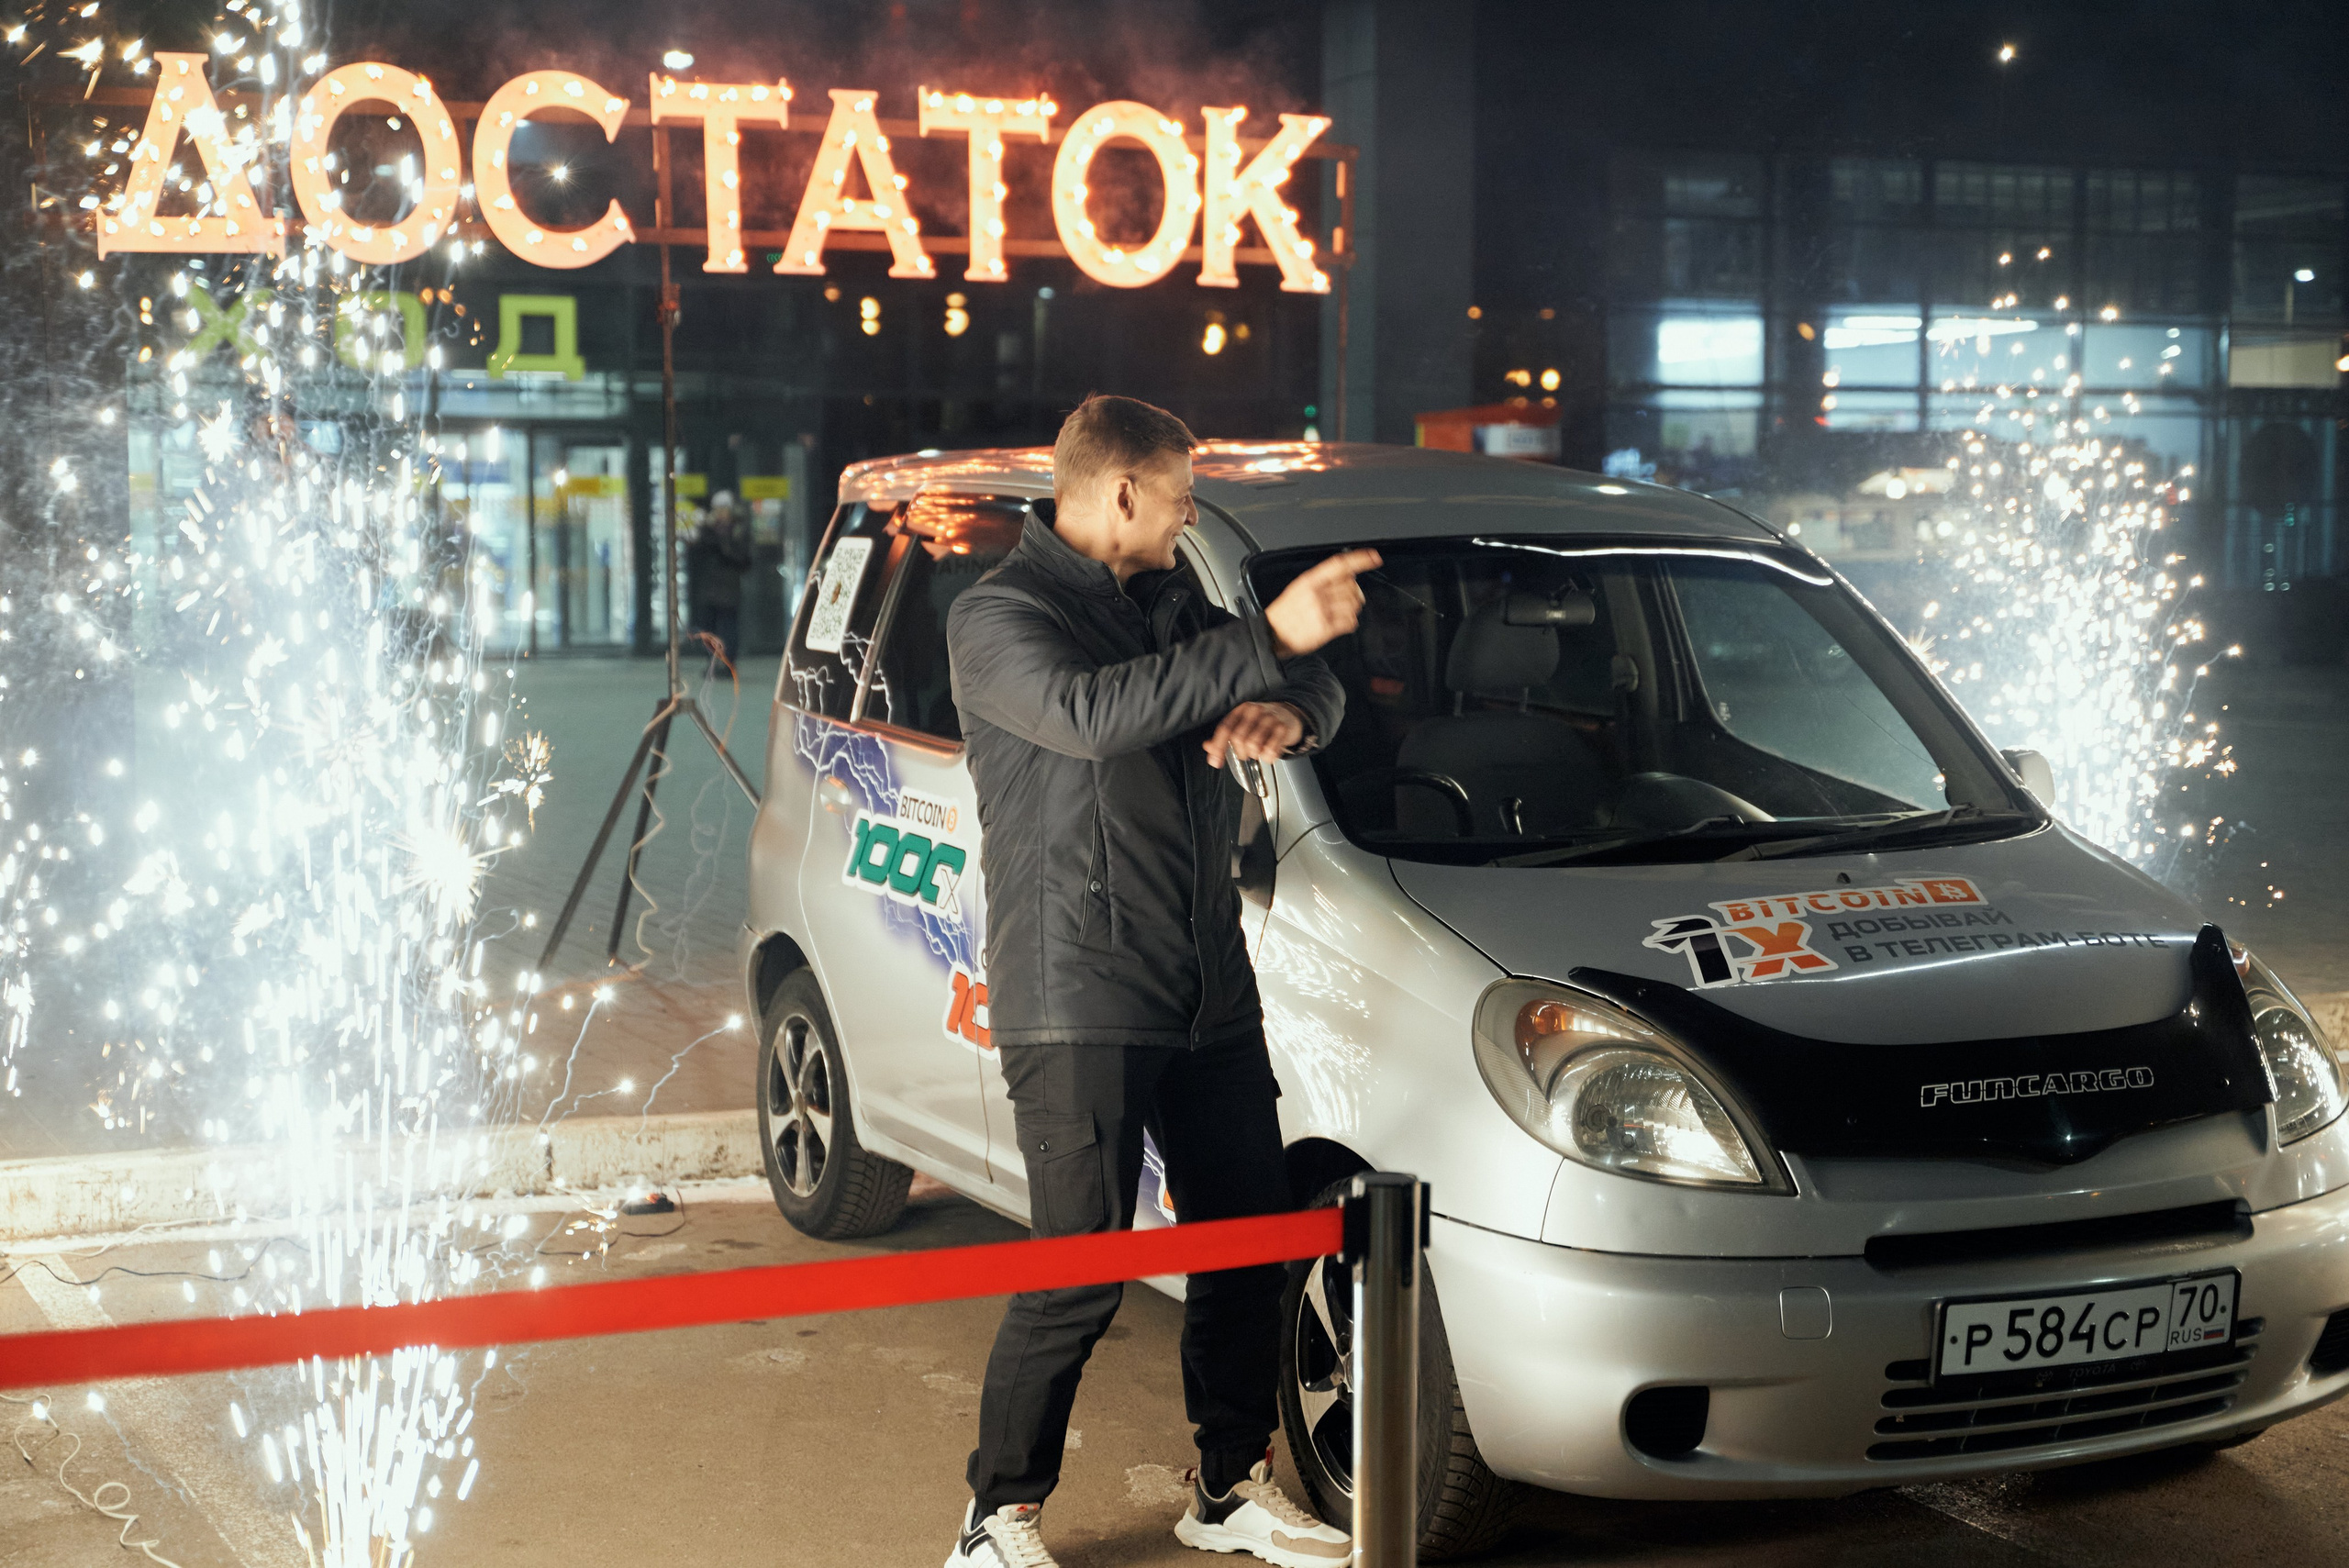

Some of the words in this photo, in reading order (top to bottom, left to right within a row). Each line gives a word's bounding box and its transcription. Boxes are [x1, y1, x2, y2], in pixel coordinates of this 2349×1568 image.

[97, 51, 1331, 294] ДОСТАТОК
[899, 795, 947, 829] BITCOIN
[1720, 886, 1929, 923] BITCOIN
[1826, 907, 2013, 941] ДОБЫВАЙ
[1842, 945, 1874, 963] В
[1874, 931, 2169, 959] ТЕЛЕГРАМ-БОТЕ
[1920, 1066, 2154, 1107] FUNCARGO
[2178, 1283, 2219, 1327] 70
[2170, 1329, 2201, 1346] RUS
[2068, 1363, 2116, 1379] TOYOTA
